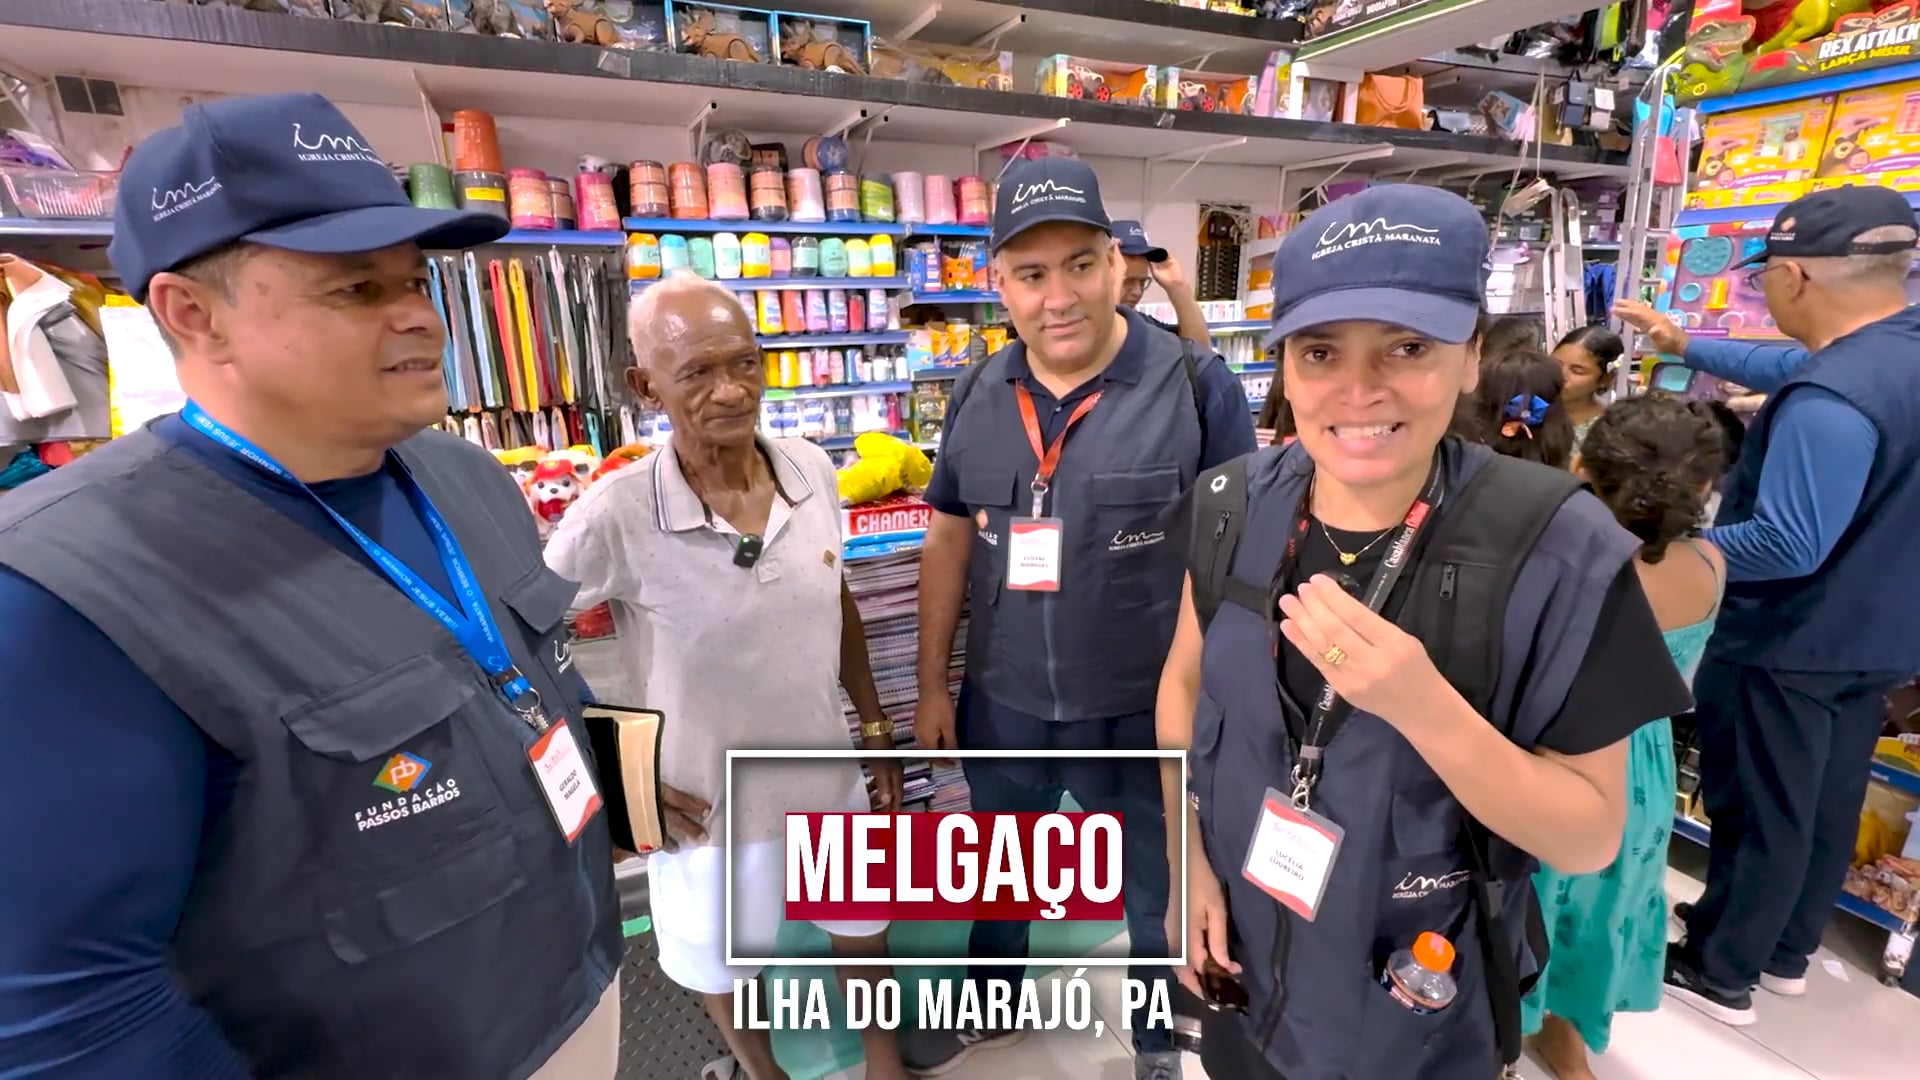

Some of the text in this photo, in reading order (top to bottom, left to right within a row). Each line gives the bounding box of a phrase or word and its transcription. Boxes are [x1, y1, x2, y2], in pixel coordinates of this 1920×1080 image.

[1819, 36, 1855, 59] REX
[1312, 233, 1441, 260] IGREJA CRISTÃ MARANATA
[211, 428, 241, 449] JESUS
[240, 447, 282, 476] SENHOR
[857, 508, 930, 533] CHAMEX
[1384, 527, 1416, 568] Casablanca
[411, 586, 436, 609] JESUS
[471, 601, 494, 643] MARANATA
[357, 787, 461, 831] PASSOS BARROS
[1269, 856, 1304, 881] LOUREIRO
